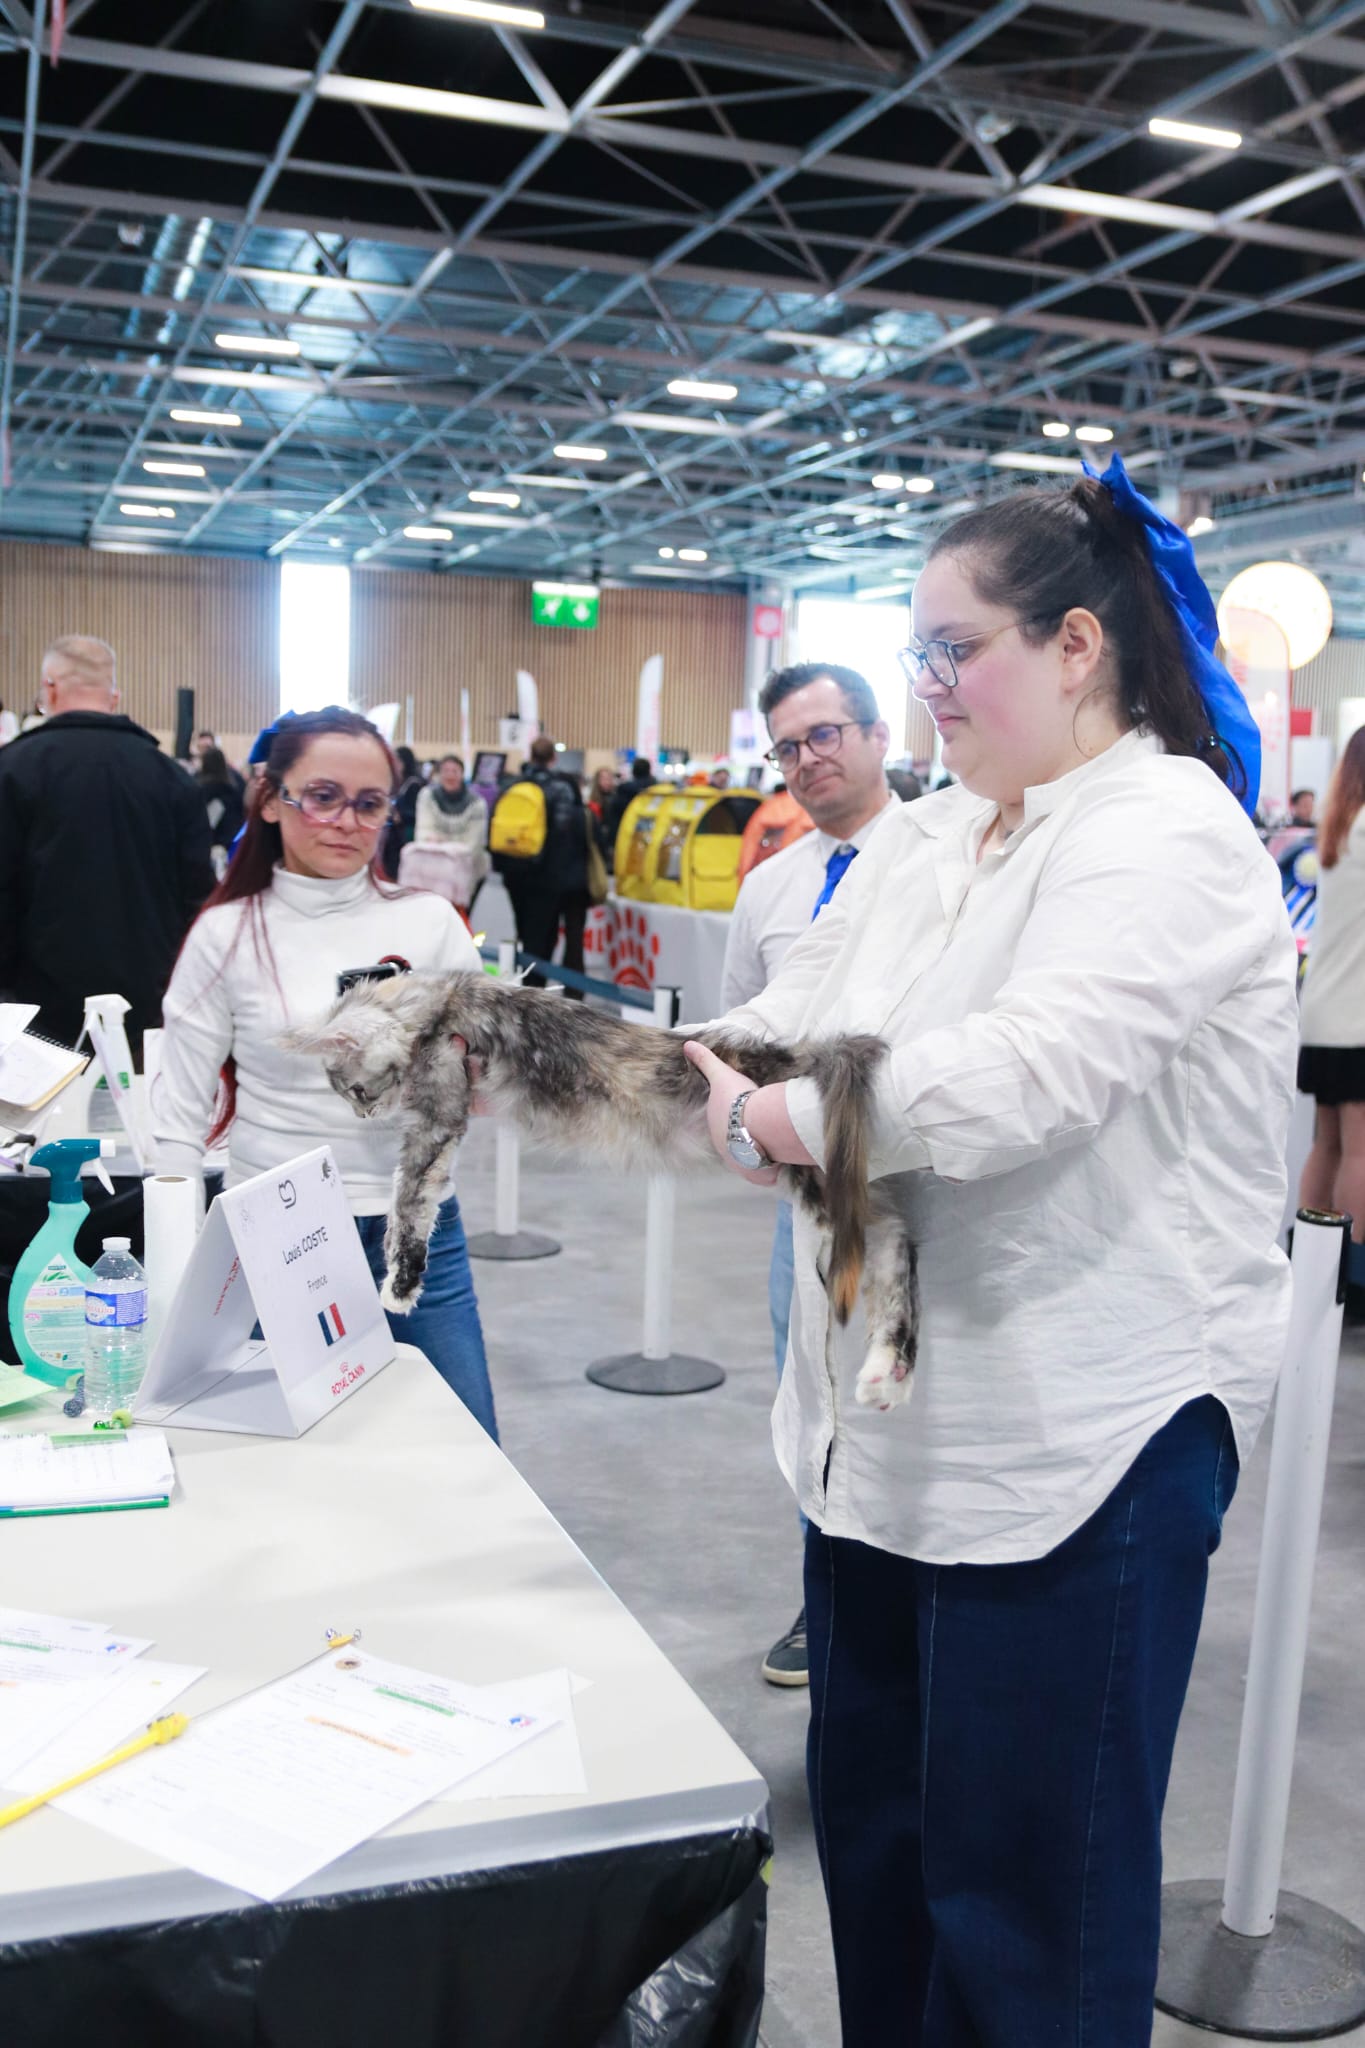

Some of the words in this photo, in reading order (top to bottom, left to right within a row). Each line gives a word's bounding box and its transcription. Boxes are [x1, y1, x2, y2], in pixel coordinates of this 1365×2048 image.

[282, 1246, 302, 1265] Louis
[302, 1226, 329, 1252] COSTE
[307, 1274, 328, 1294] France
[331, 1376, 349, 1397] ROYAL
